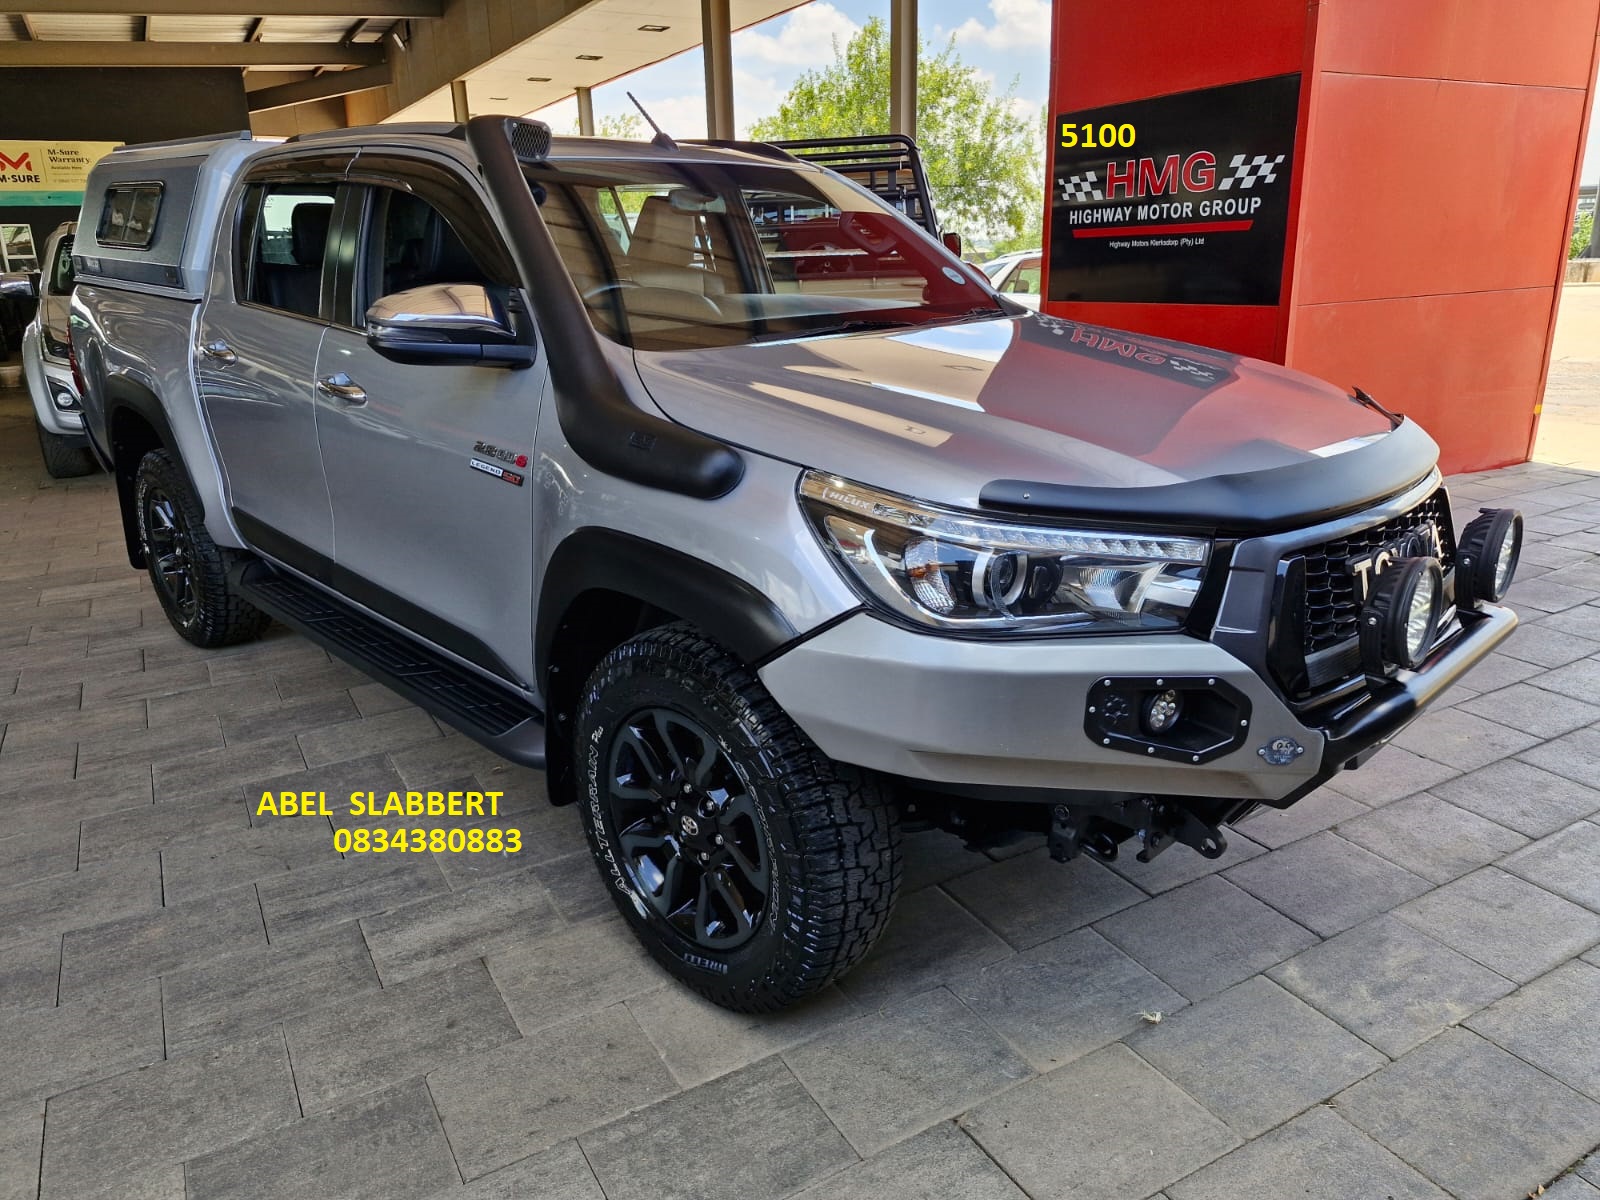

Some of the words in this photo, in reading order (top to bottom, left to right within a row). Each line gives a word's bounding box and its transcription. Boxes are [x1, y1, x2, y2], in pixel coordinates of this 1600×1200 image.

[1106, 150, 1217, 200] HMG
[1069, 206, 1132, 225] HIGHWAY
[1137, 202, 1193, 220] MOTOR
[1199, 197, 1262, 217] GROUP
[1109, 240, 1131, 249] Highway
[1131, 239, 1149, 247] Motors
[1180, 236, 1194, 247] (Pty)
[1194, 236, 1205, 245] Ltd
[471, 460, 502, 475] LEGEND
[588, 744, 609, 850] TERRAIN
